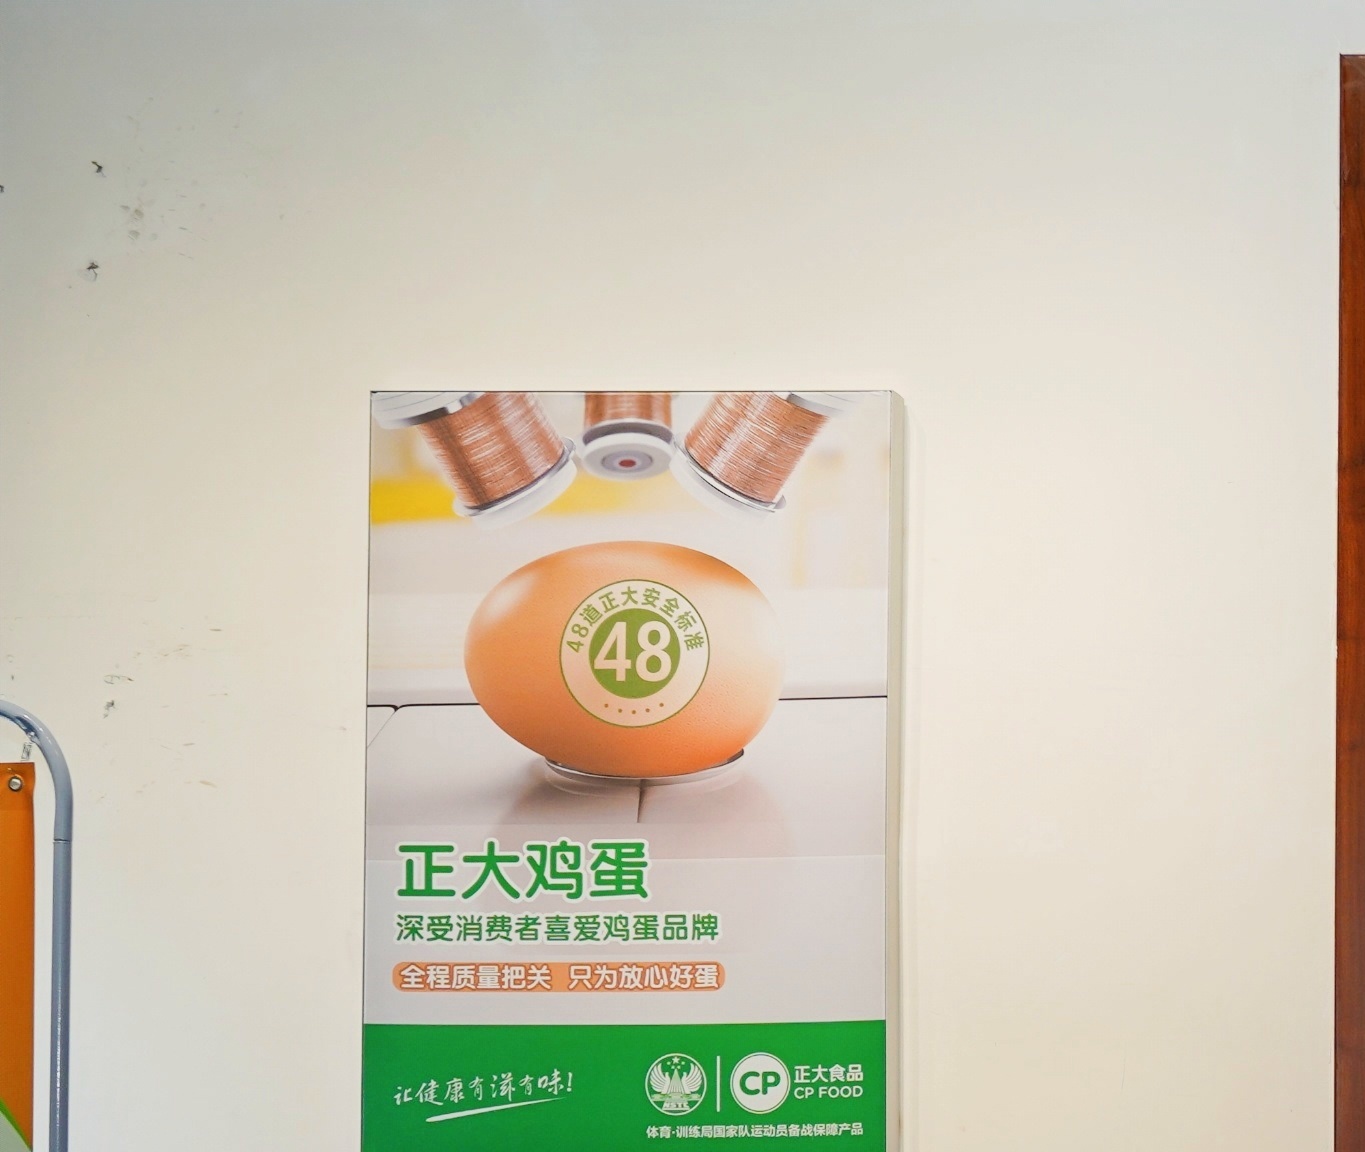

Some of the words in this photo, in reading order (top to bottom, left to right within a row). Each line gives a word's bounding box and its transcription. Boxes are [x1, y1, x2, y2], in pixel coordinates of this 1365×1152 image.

[566, 586, 706, 655] 48道正大安全标准
[593, 620, 673, 683] 48
[397, 840, 648, 900] 正大鸡蛋
[396, 913, 720, 943] 深受消费者喜爱鸡蛋品牌
[399, 964, 552, 990] 全程质量把关
[568, 963, 720, 989] 只为放心好蛋
[393, 1069, 573, 1105] 让健康有滋有味!
[739, 1071, 781, 1096] CP
[794, 1064, 864, 1084] 正大食品
[794, 1087, 814, 1099] CP
[818, 1086, 864, 1099] FOOD
[646, 1123, 864, 1139] 体育·训练局国家队运动员备战保障产品
